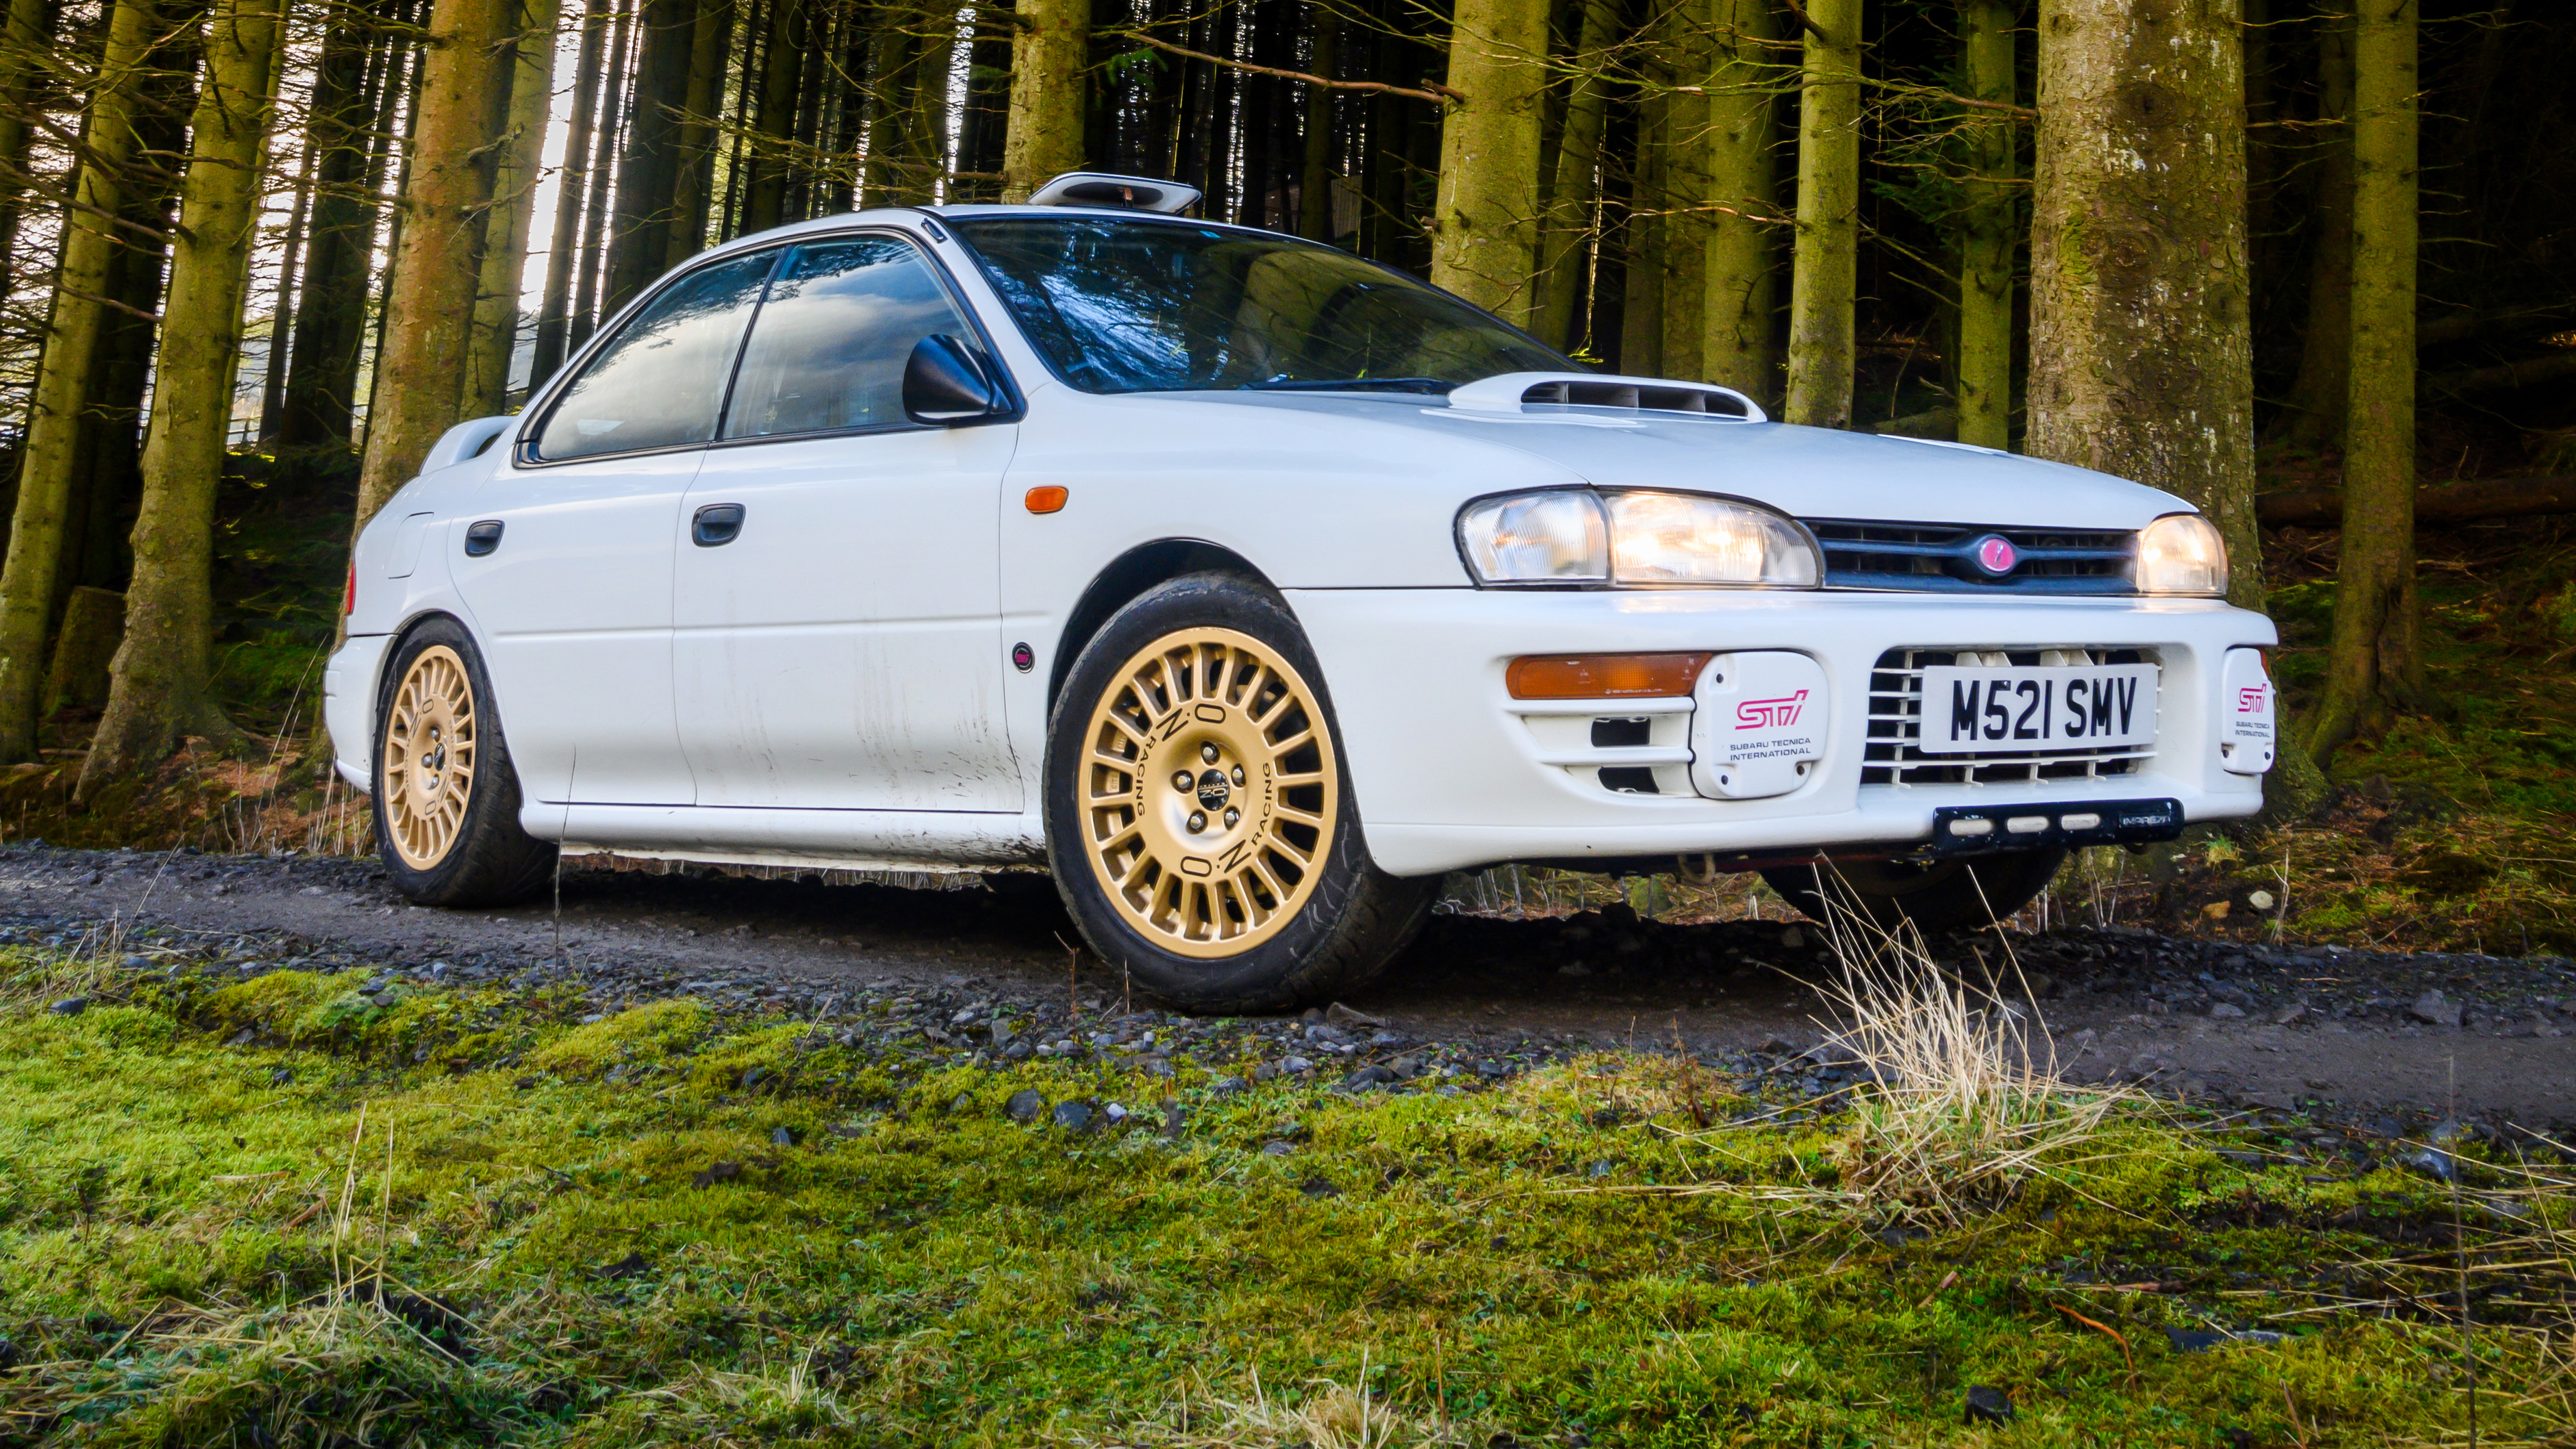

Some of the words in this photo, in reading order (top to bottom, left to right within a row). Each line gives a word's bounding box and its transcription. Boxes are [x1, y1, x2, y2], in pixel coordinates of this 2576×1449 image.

[1951, 679, 2053, 741] M521
[2064, 677, 2137, 738] SMV
[1730, 741, 1769, 751] SUBARU
[1771, 738, 1811, 747] TECNICA
[2235, 730, 2270, 738] INTERNATIONAL
[1730, 748, 1811, 761] INTERNATIONAL
[1136, 735, 1157, 816] RACING
[1251, 763, 1272, 846] RACING
